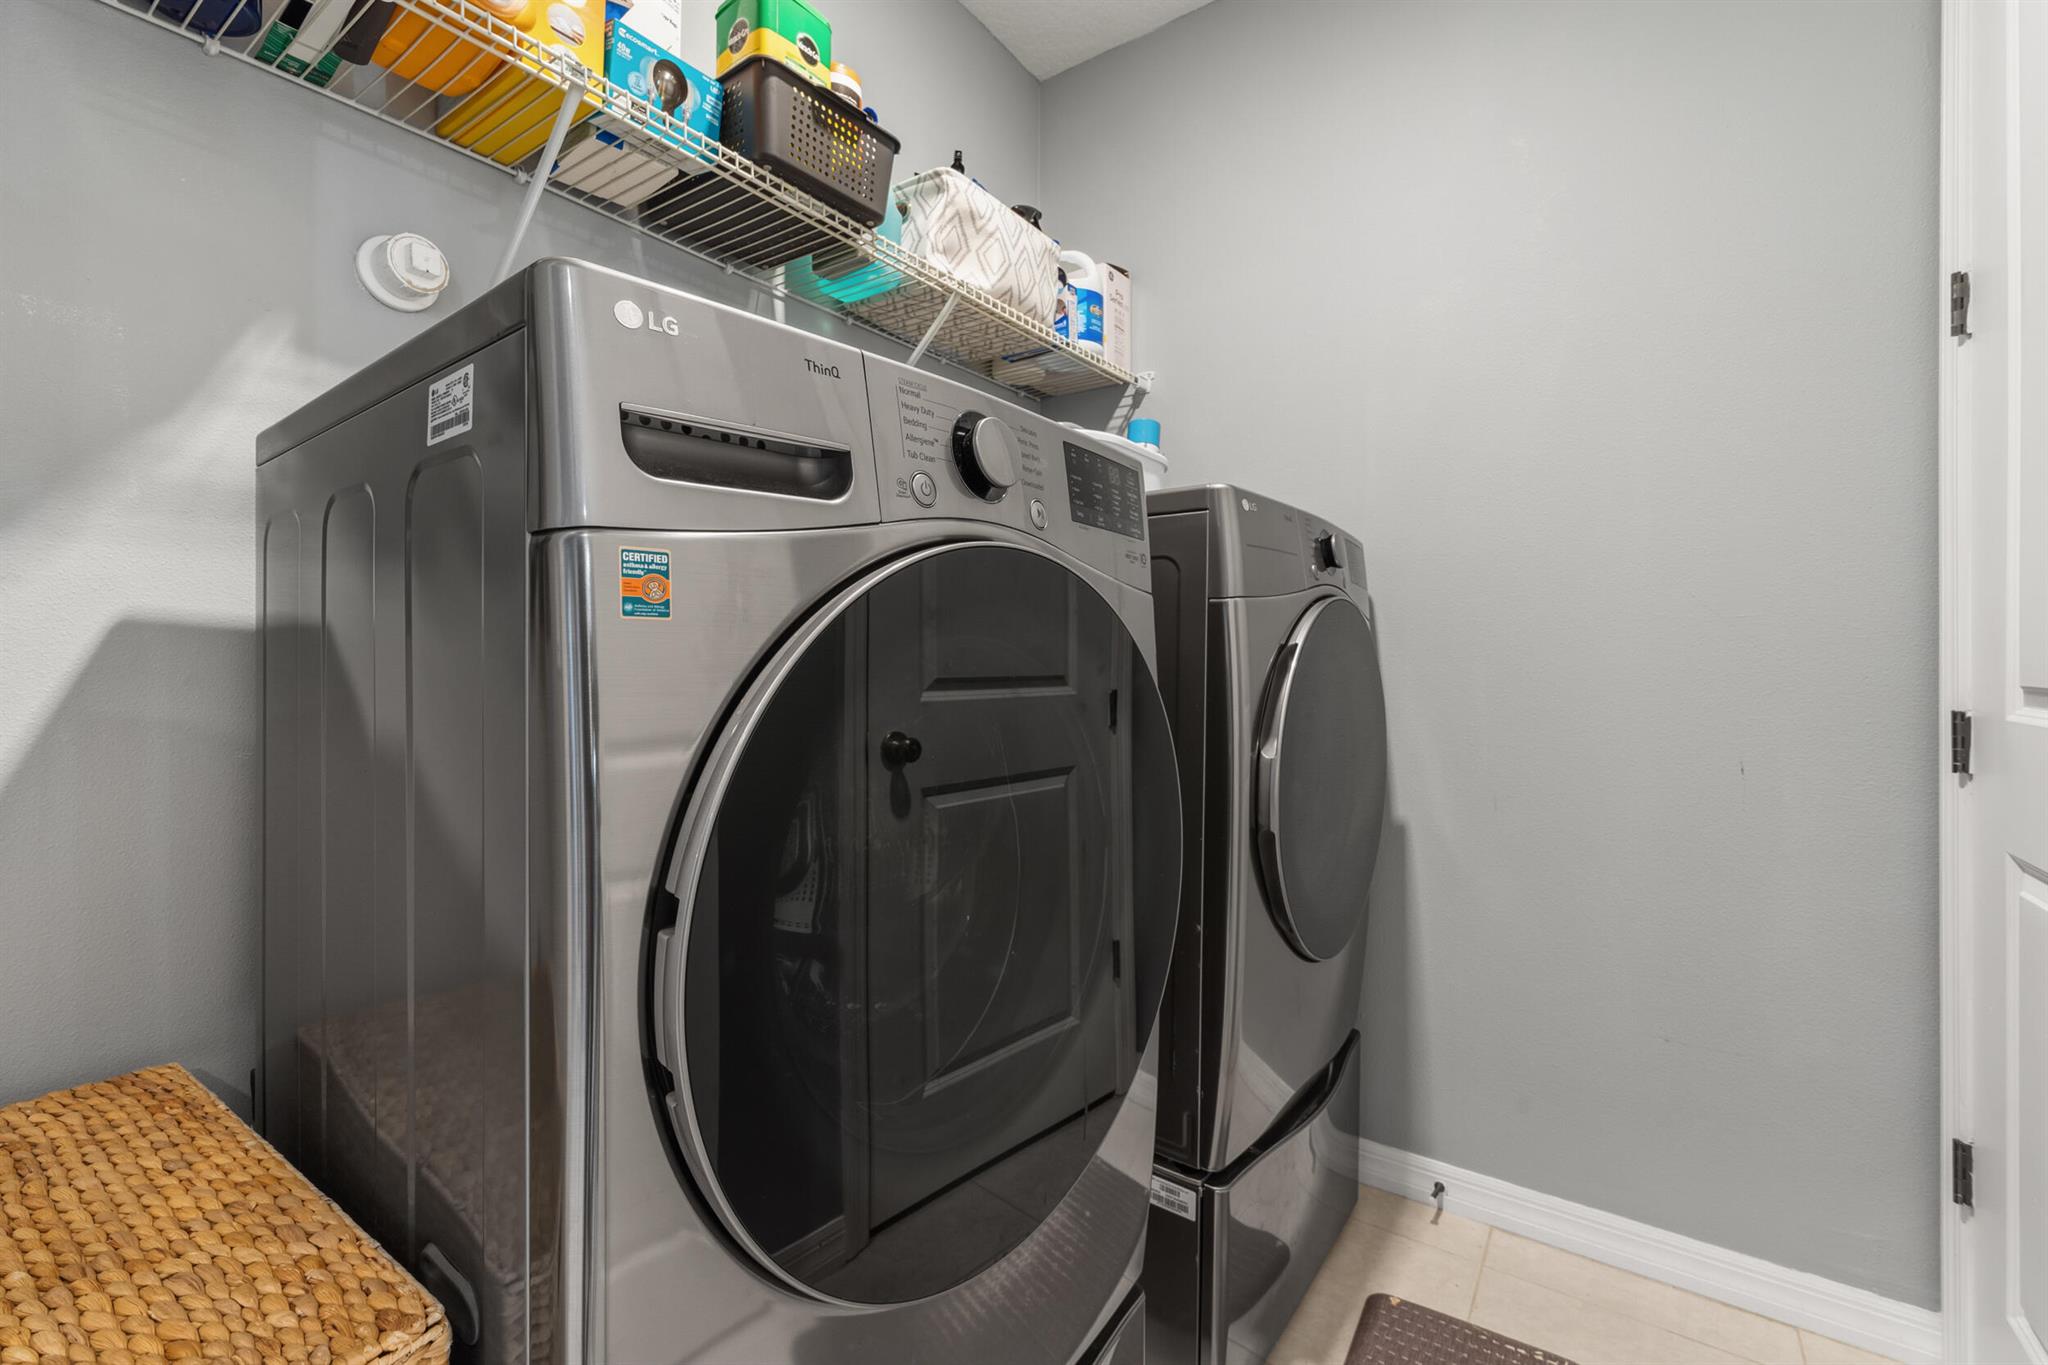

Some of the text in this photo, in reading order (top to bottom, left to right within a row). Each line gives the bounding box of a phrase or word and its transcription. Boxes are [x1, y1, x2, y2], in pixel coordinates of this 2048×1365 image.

[648, 311, 679, 336] LG
[804, 358, 841, 379] ThinQ
[899, 386, 921, 399] Normal
[901, 400, 935, 419] Heavy Duty
[903, 415, 928, 431] Bedding
[907, 449, 936, 463] Tub Clean
[622, 551, 668, 564] CERTIFIED
